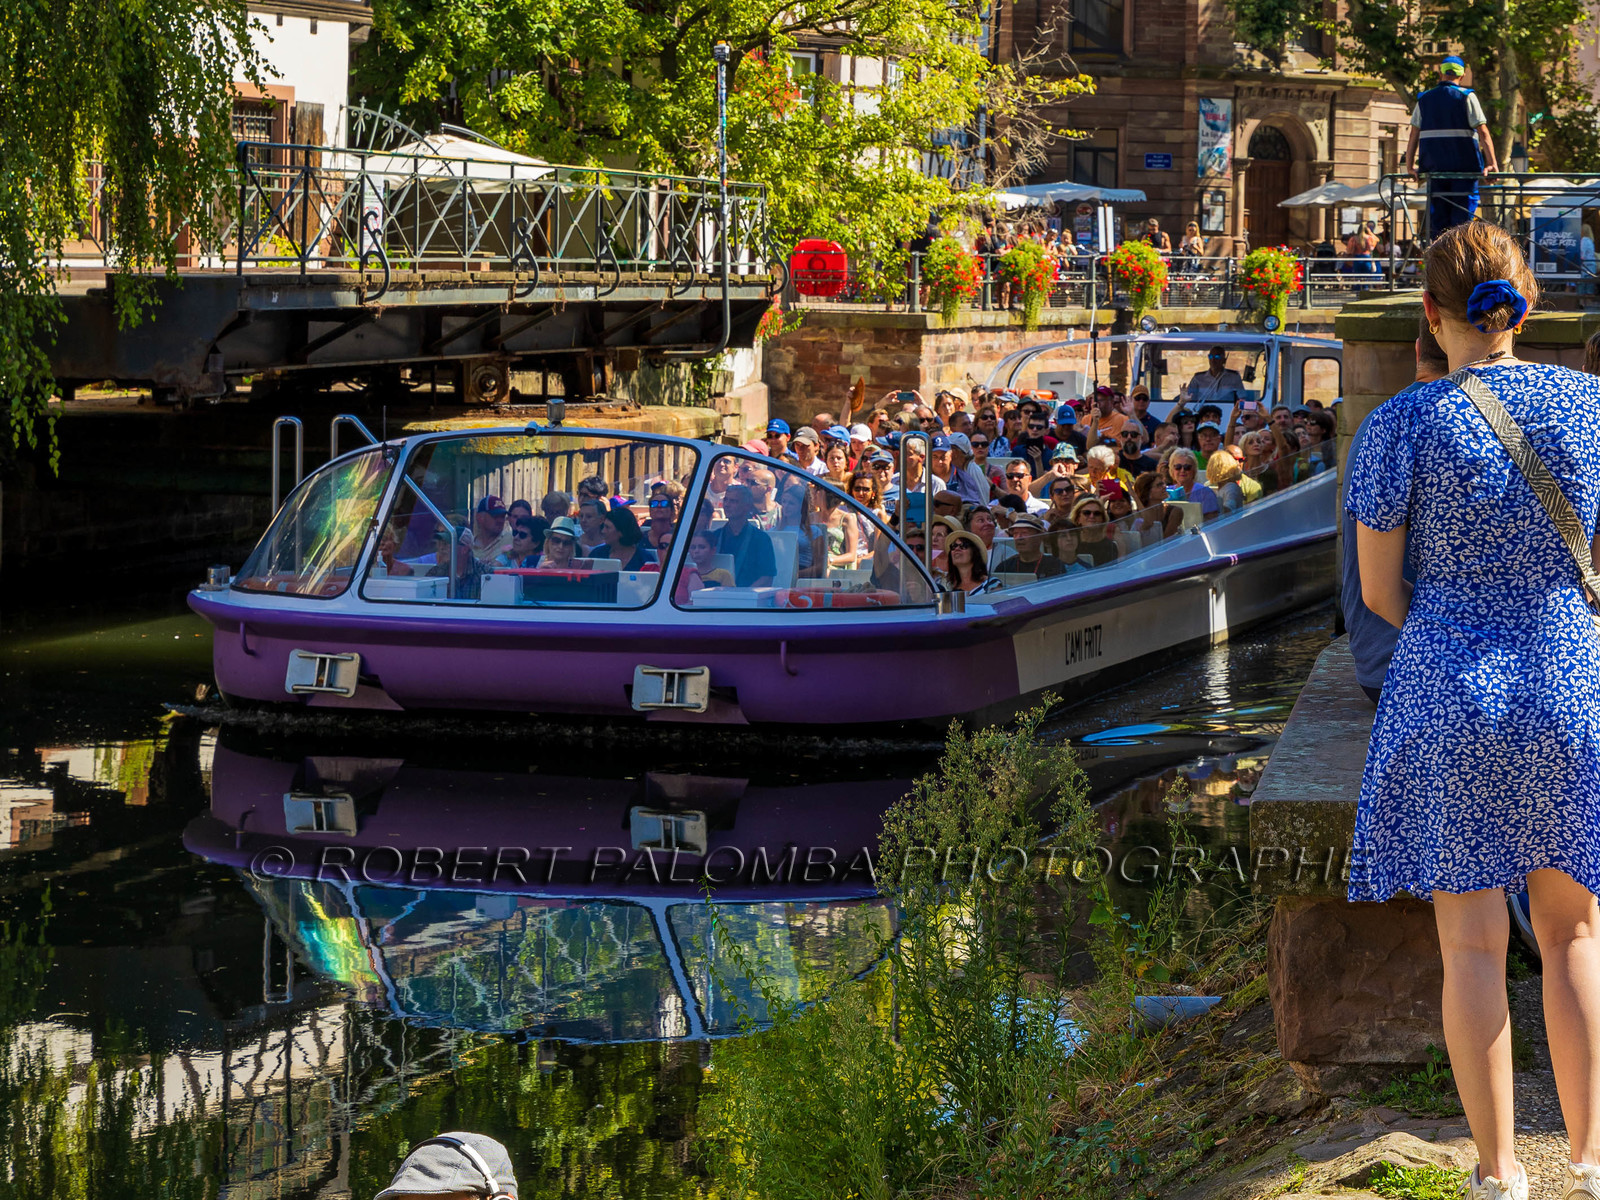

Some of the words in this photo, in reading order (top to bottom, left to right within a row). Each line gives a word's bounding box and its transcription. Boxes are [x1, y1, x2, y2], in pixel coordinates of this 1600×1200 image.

[1205, 113, 1227, 121] BIBLE
[1065, 629, 1083, 665] L'AMI
[1084, 624, 1102, 660] FRITZ
